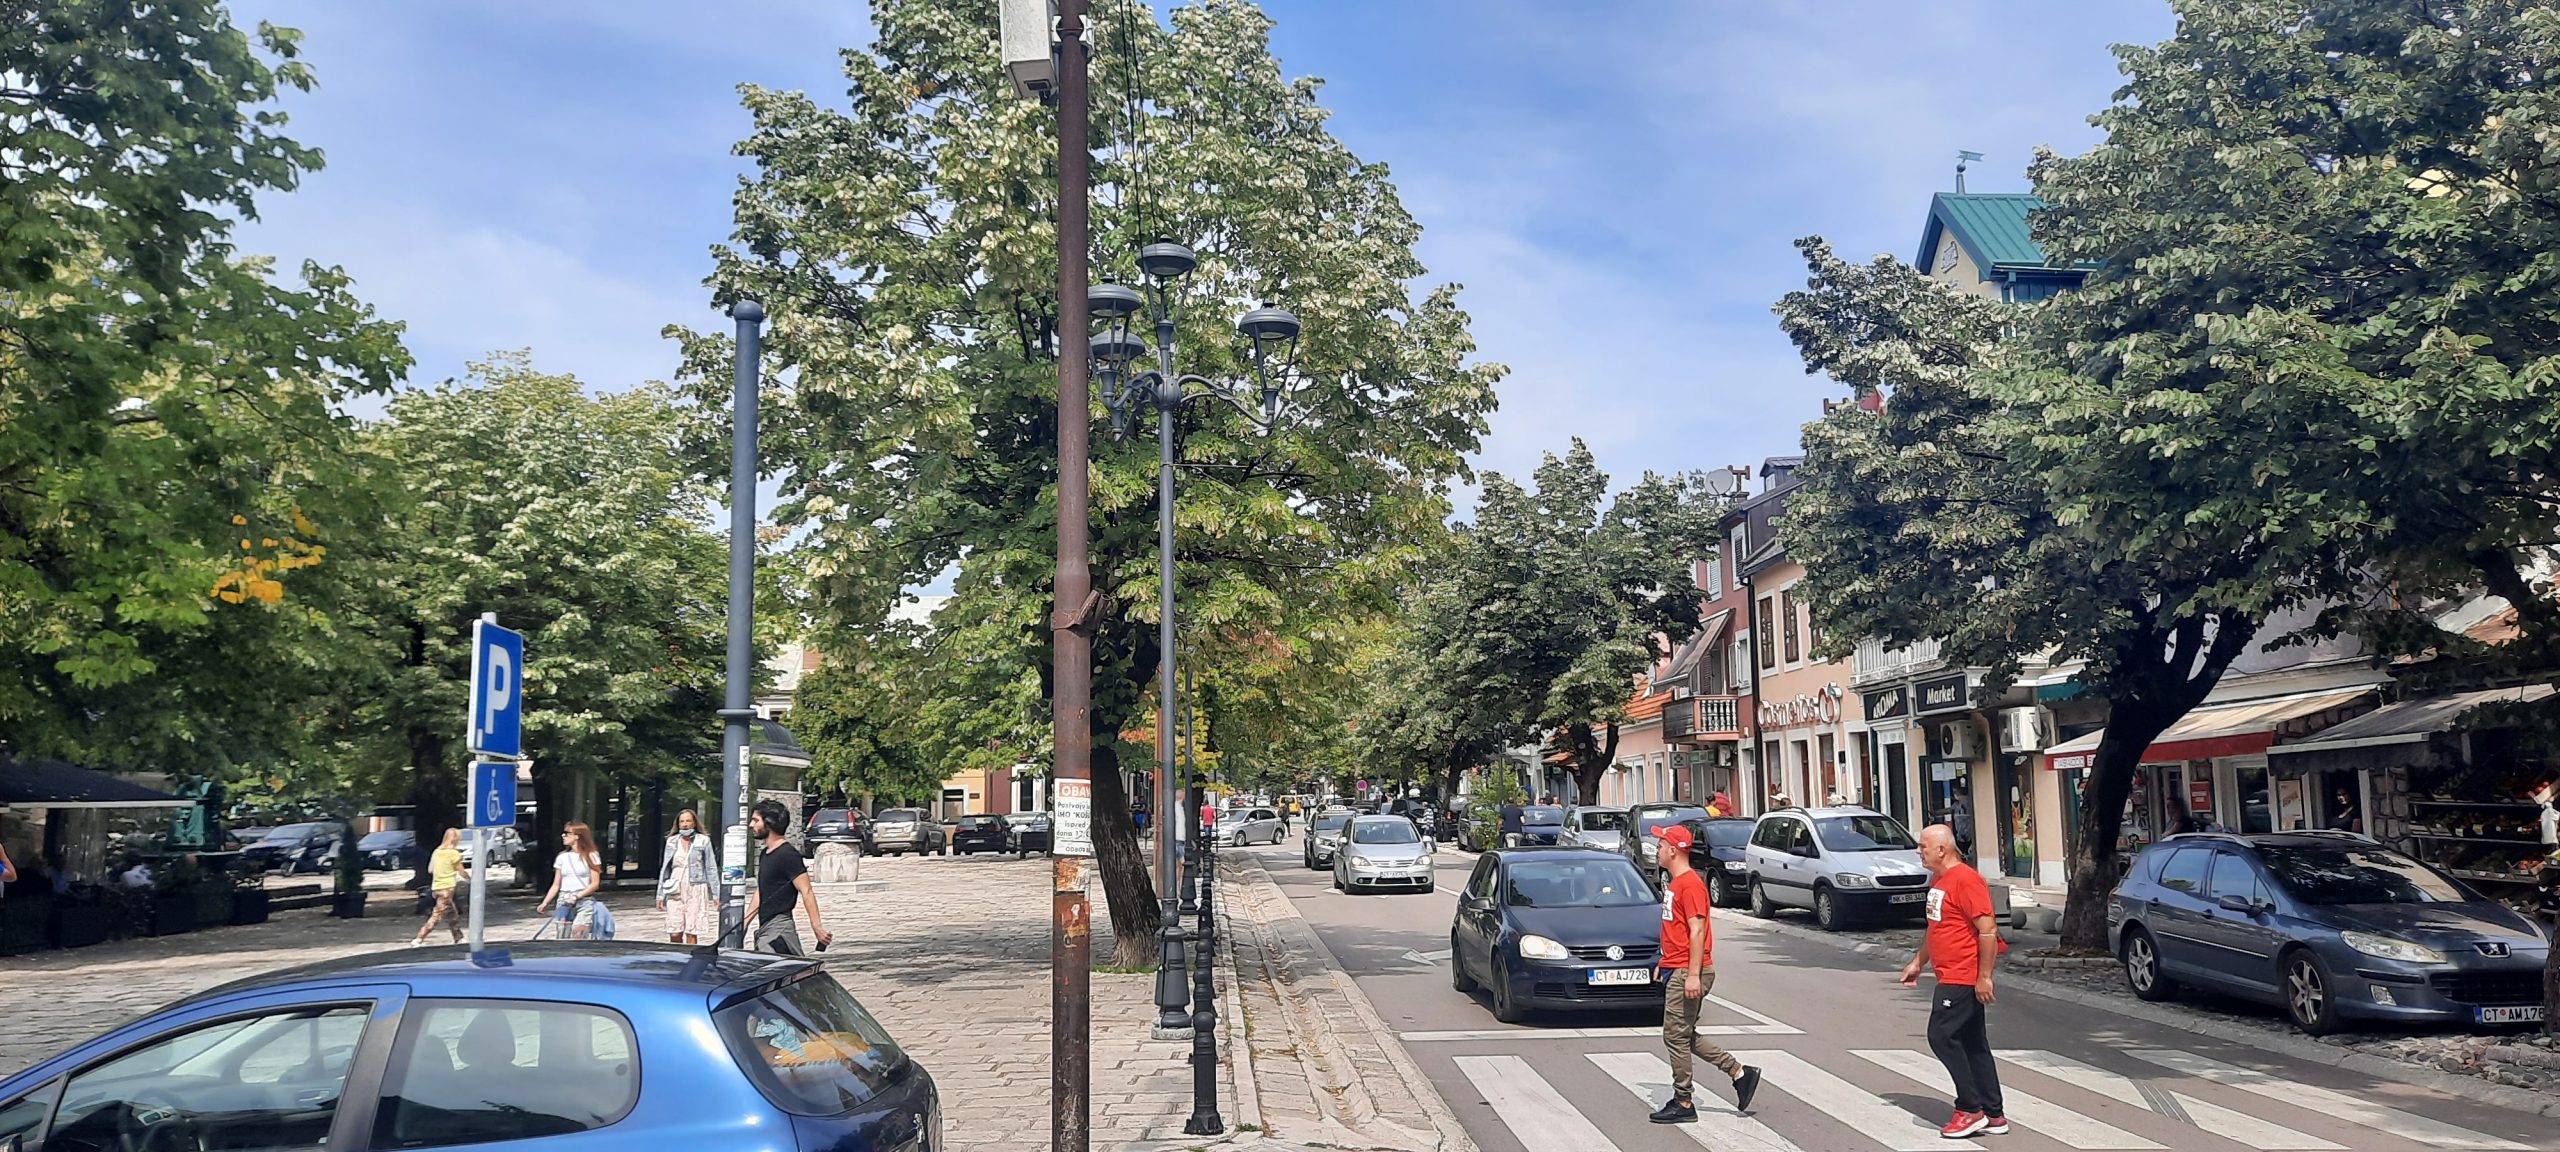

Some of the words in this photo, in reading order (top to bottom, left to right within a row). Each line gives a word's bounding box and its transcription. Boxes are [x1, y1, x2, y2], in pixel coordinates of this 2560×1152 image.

[485, 643, 512, 735] P
[1926, 685, 1955, 705] Market
[1873, 690, 1899, 719] AROMA
[1616, 969, 1648, 981] AJ728
